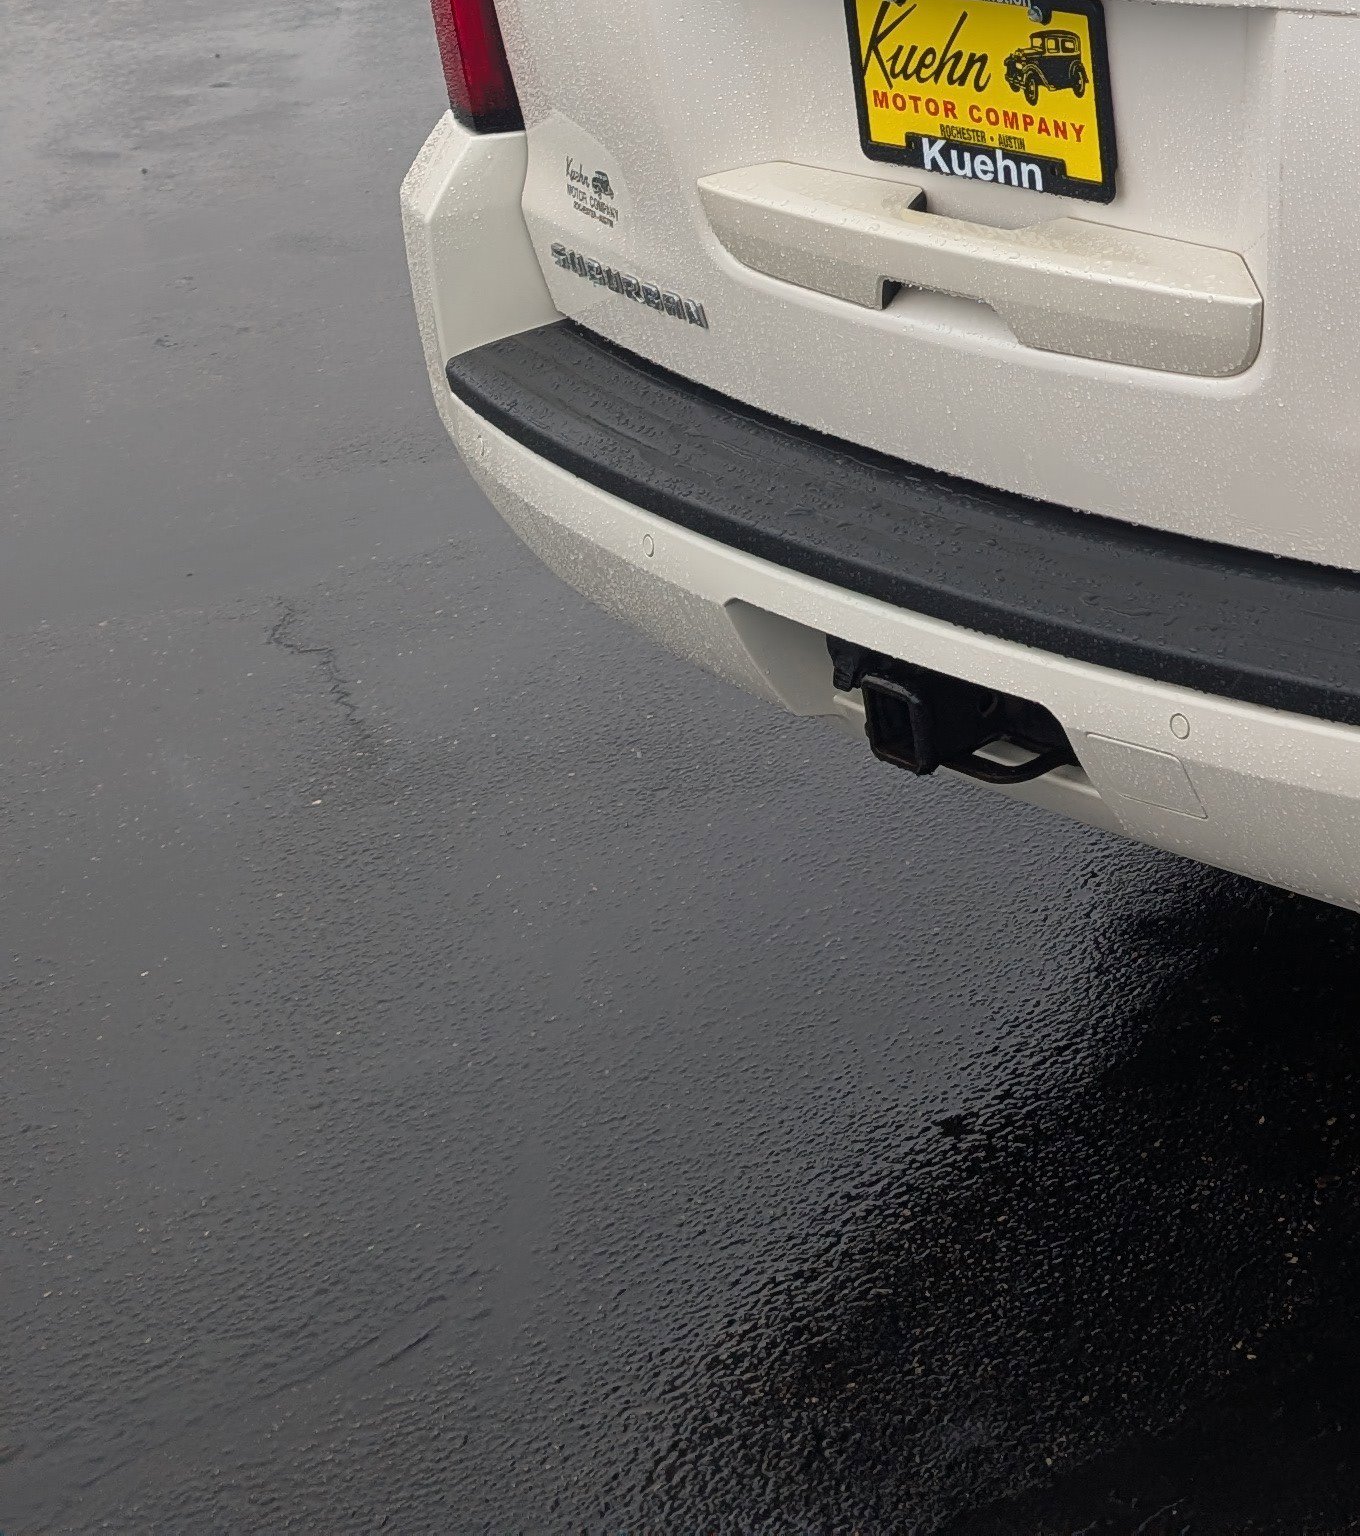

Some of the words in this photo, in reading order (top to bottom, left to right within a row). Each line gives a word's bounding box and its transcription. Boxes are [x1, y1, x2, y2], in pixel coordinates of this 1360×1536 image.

[864, 1, 991, 92] Kuehn
[873, 90, 958, 120] MOTOR
[969, 105, 1085, 143] COMPANY
[940, 124, 986, 144] ROCHESTER
[922, 138, 1043, 191] Kuehn
[551, 242, 709, 329] SUBURBAN
